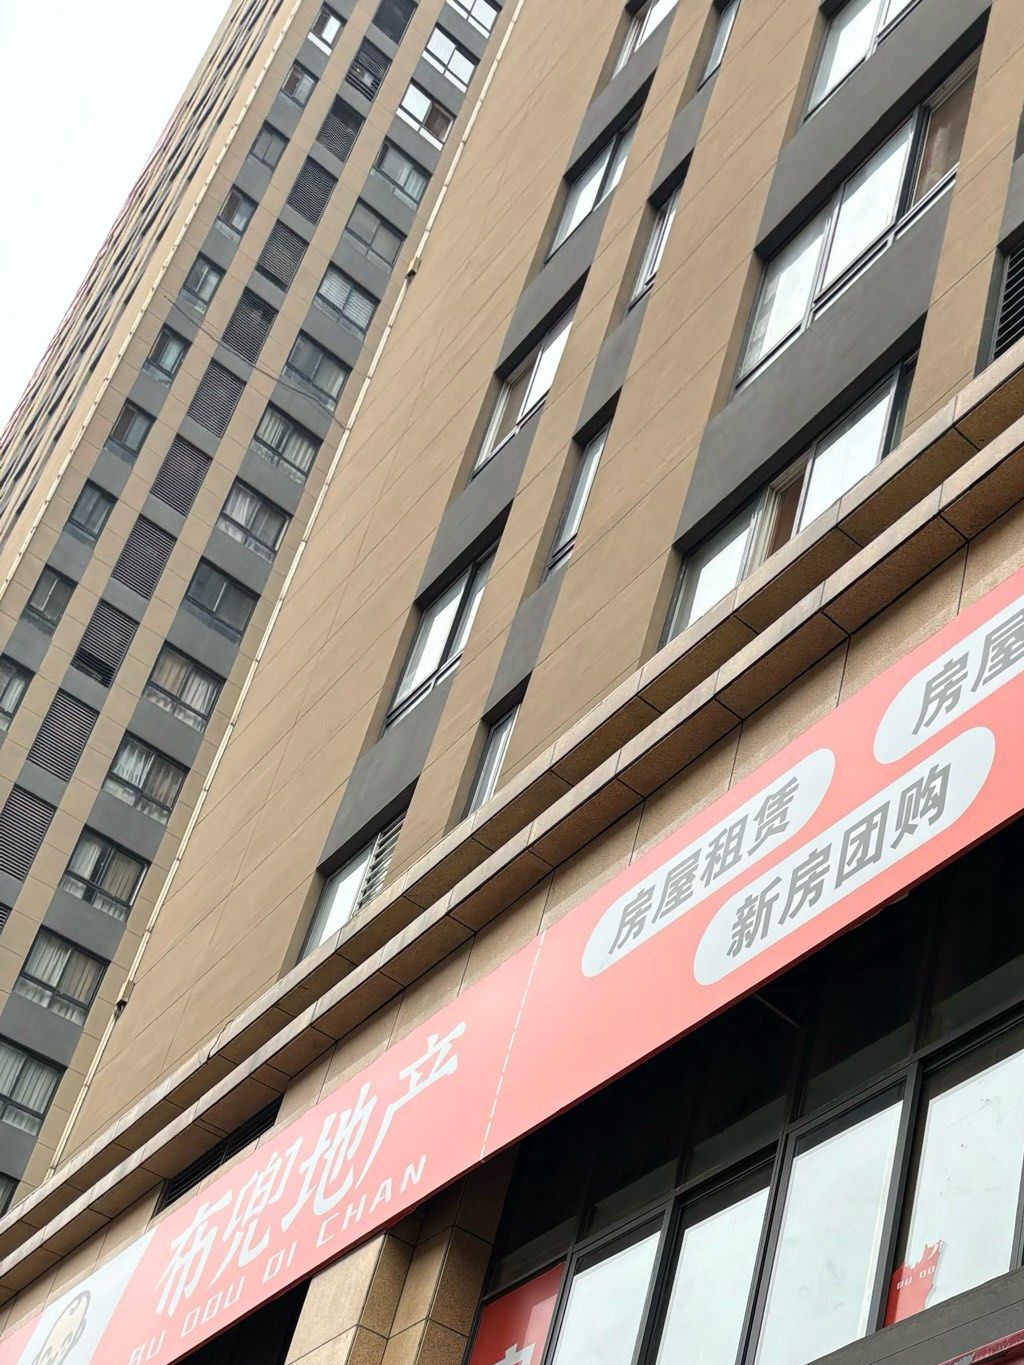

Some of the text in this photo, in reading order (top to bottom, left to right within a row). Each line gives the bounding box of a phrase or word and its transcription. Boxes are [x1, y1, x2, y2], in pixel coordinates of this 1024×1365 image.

[608, 776, 800, 955] 房屋租赁
[726, 763, 952, 958] 新房团购
[153, 1021, 467, 1319] 布兜地产
[315, 1153, 428, 1249] CHAN
